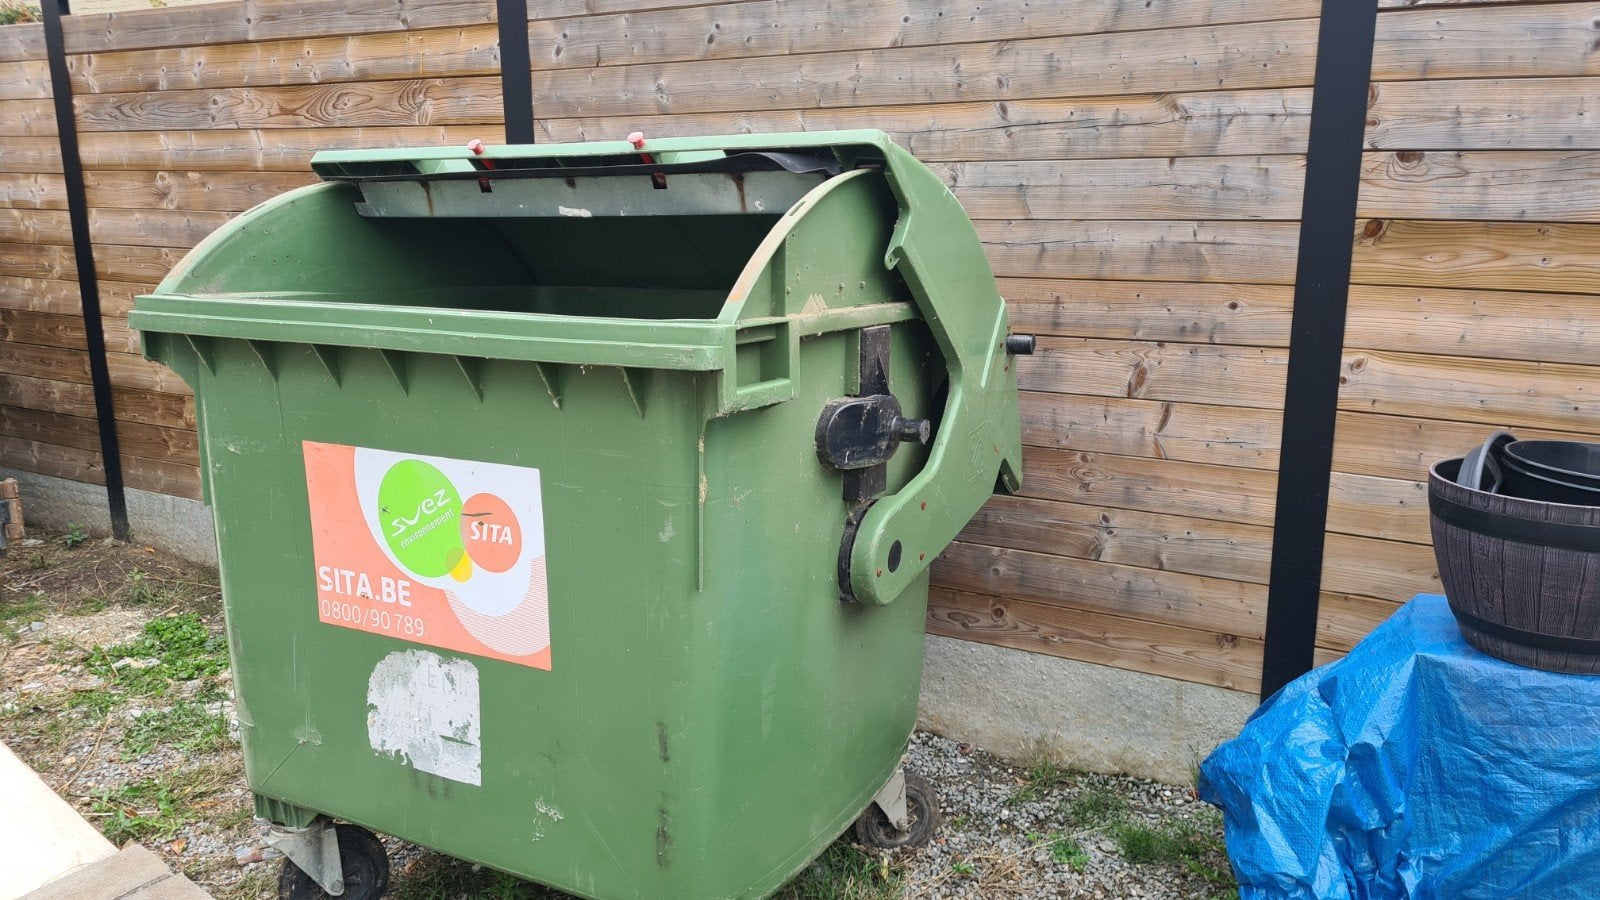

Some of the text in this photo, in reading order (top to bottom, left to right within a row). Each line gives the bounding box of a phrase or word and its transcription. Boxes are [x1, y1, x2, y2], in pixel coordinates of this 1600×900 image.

[400, 509, 455, 549] environnement
[470, 521, 513, 545] SITA
[318, 565, 412, 607] SITA.BE
[321, 600, 424, 637] 0800/90 789
